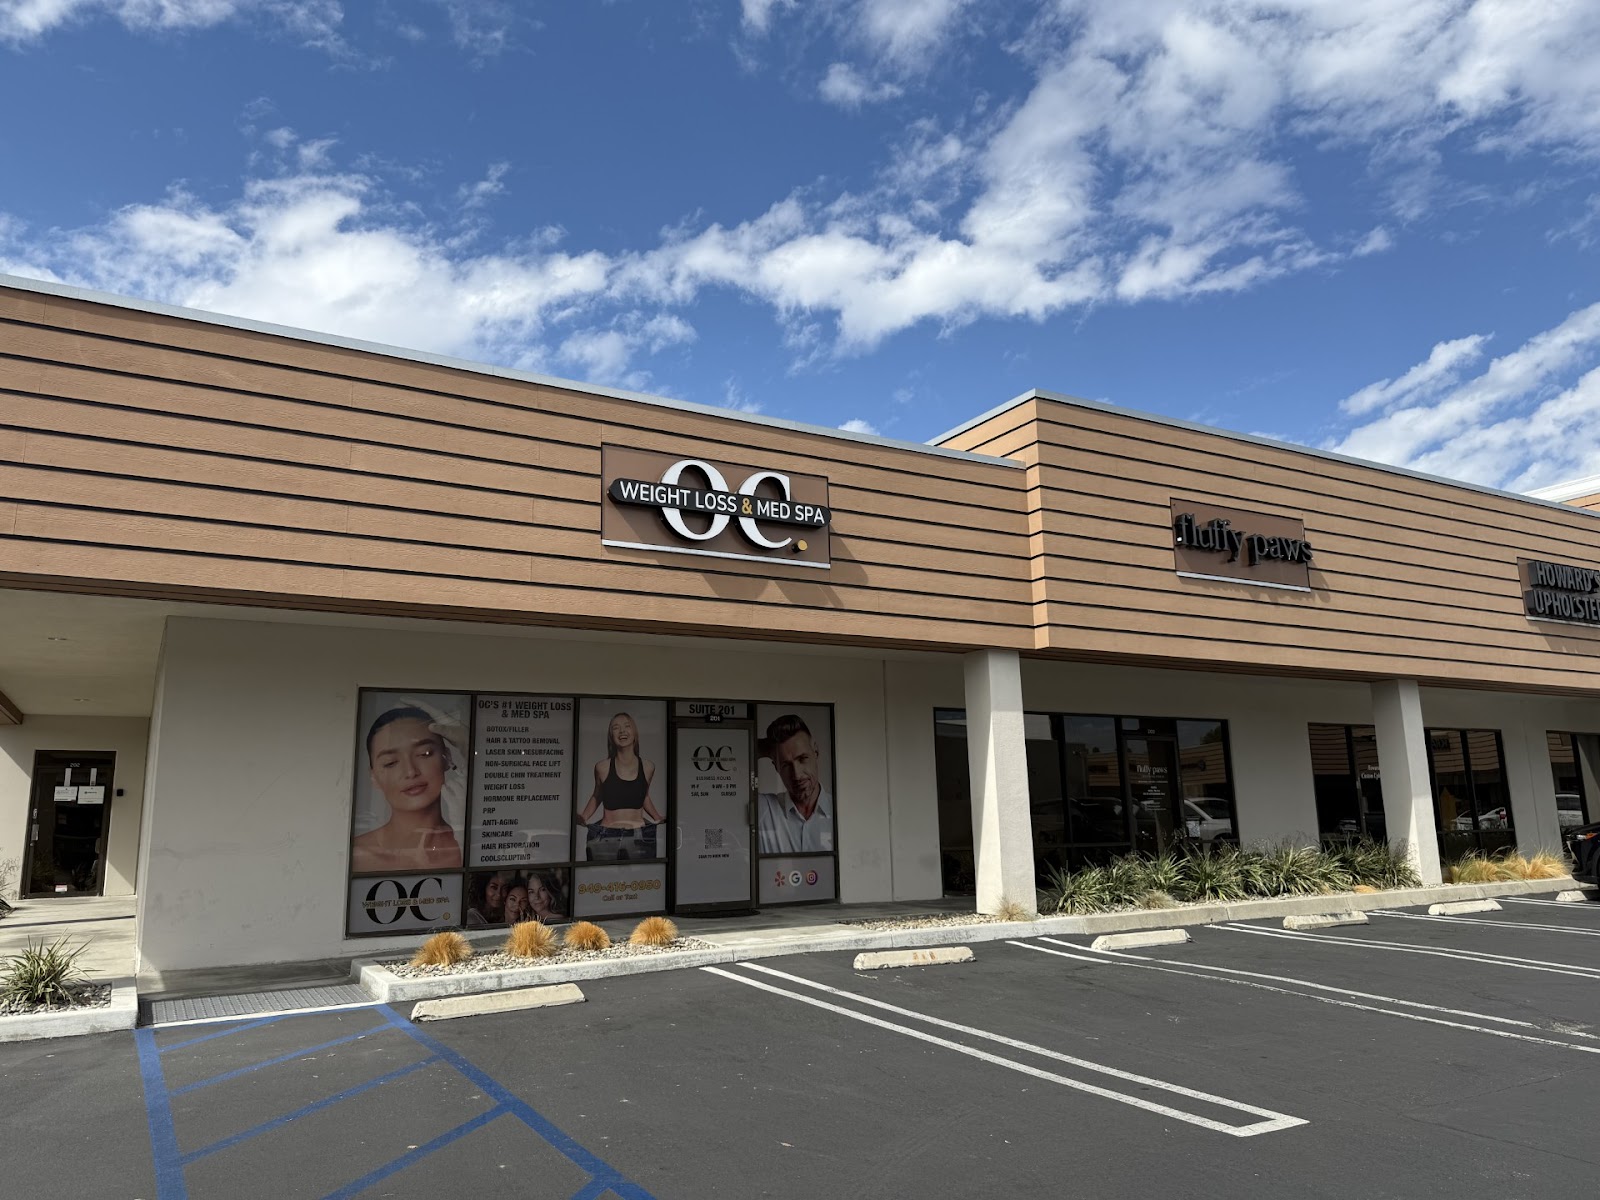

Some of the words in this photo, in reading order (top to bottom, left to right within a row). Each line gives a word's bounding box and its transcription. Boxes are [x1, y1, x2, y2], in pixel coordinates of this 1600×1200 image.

[619, 480, 691, 506] WEIGHT
[695, 491, 737, 513] LOSS
[741, 498, 753, 515] &
[757, 500, 791, 520] MED
[794, 504, 825, 524] SPA
[1176, 512, 1246, 562] fluffy
[1250, 533, 1313, 566] paws
[1535, 561, 1600, 592] HOWARD'S
[478, 700, 499, 709] OC'S
[501, 700, 512, 709] #1
[515, 701, 548, 711] WEIGHT
[550, 702, 572, 711] LOSS
[689, 703, 716, 714] SUITE
[718, 705, 735, 715] 201
[501, 709, 508, 719] &
[511, 709, 531, 719] MED
[533, 710, 550, 719] SPA
[532, 737, 560, 745] REMOVAL
[483, 783, 508, 791] WEIGHT
[516, 794, 560, 802] REPLACEMENT
[482, 818, 519, 826] ANTI-AGING
[481, 830, 513, 838] SKINCARE
[498, 841, 540, 850] RESTORATION
[362, 900, 393, 909] WEIGHT
[393, 898, 411, 907] LOSS
[419, 897, 434, 905] MED
[436, 896, 450, 904] SPA
